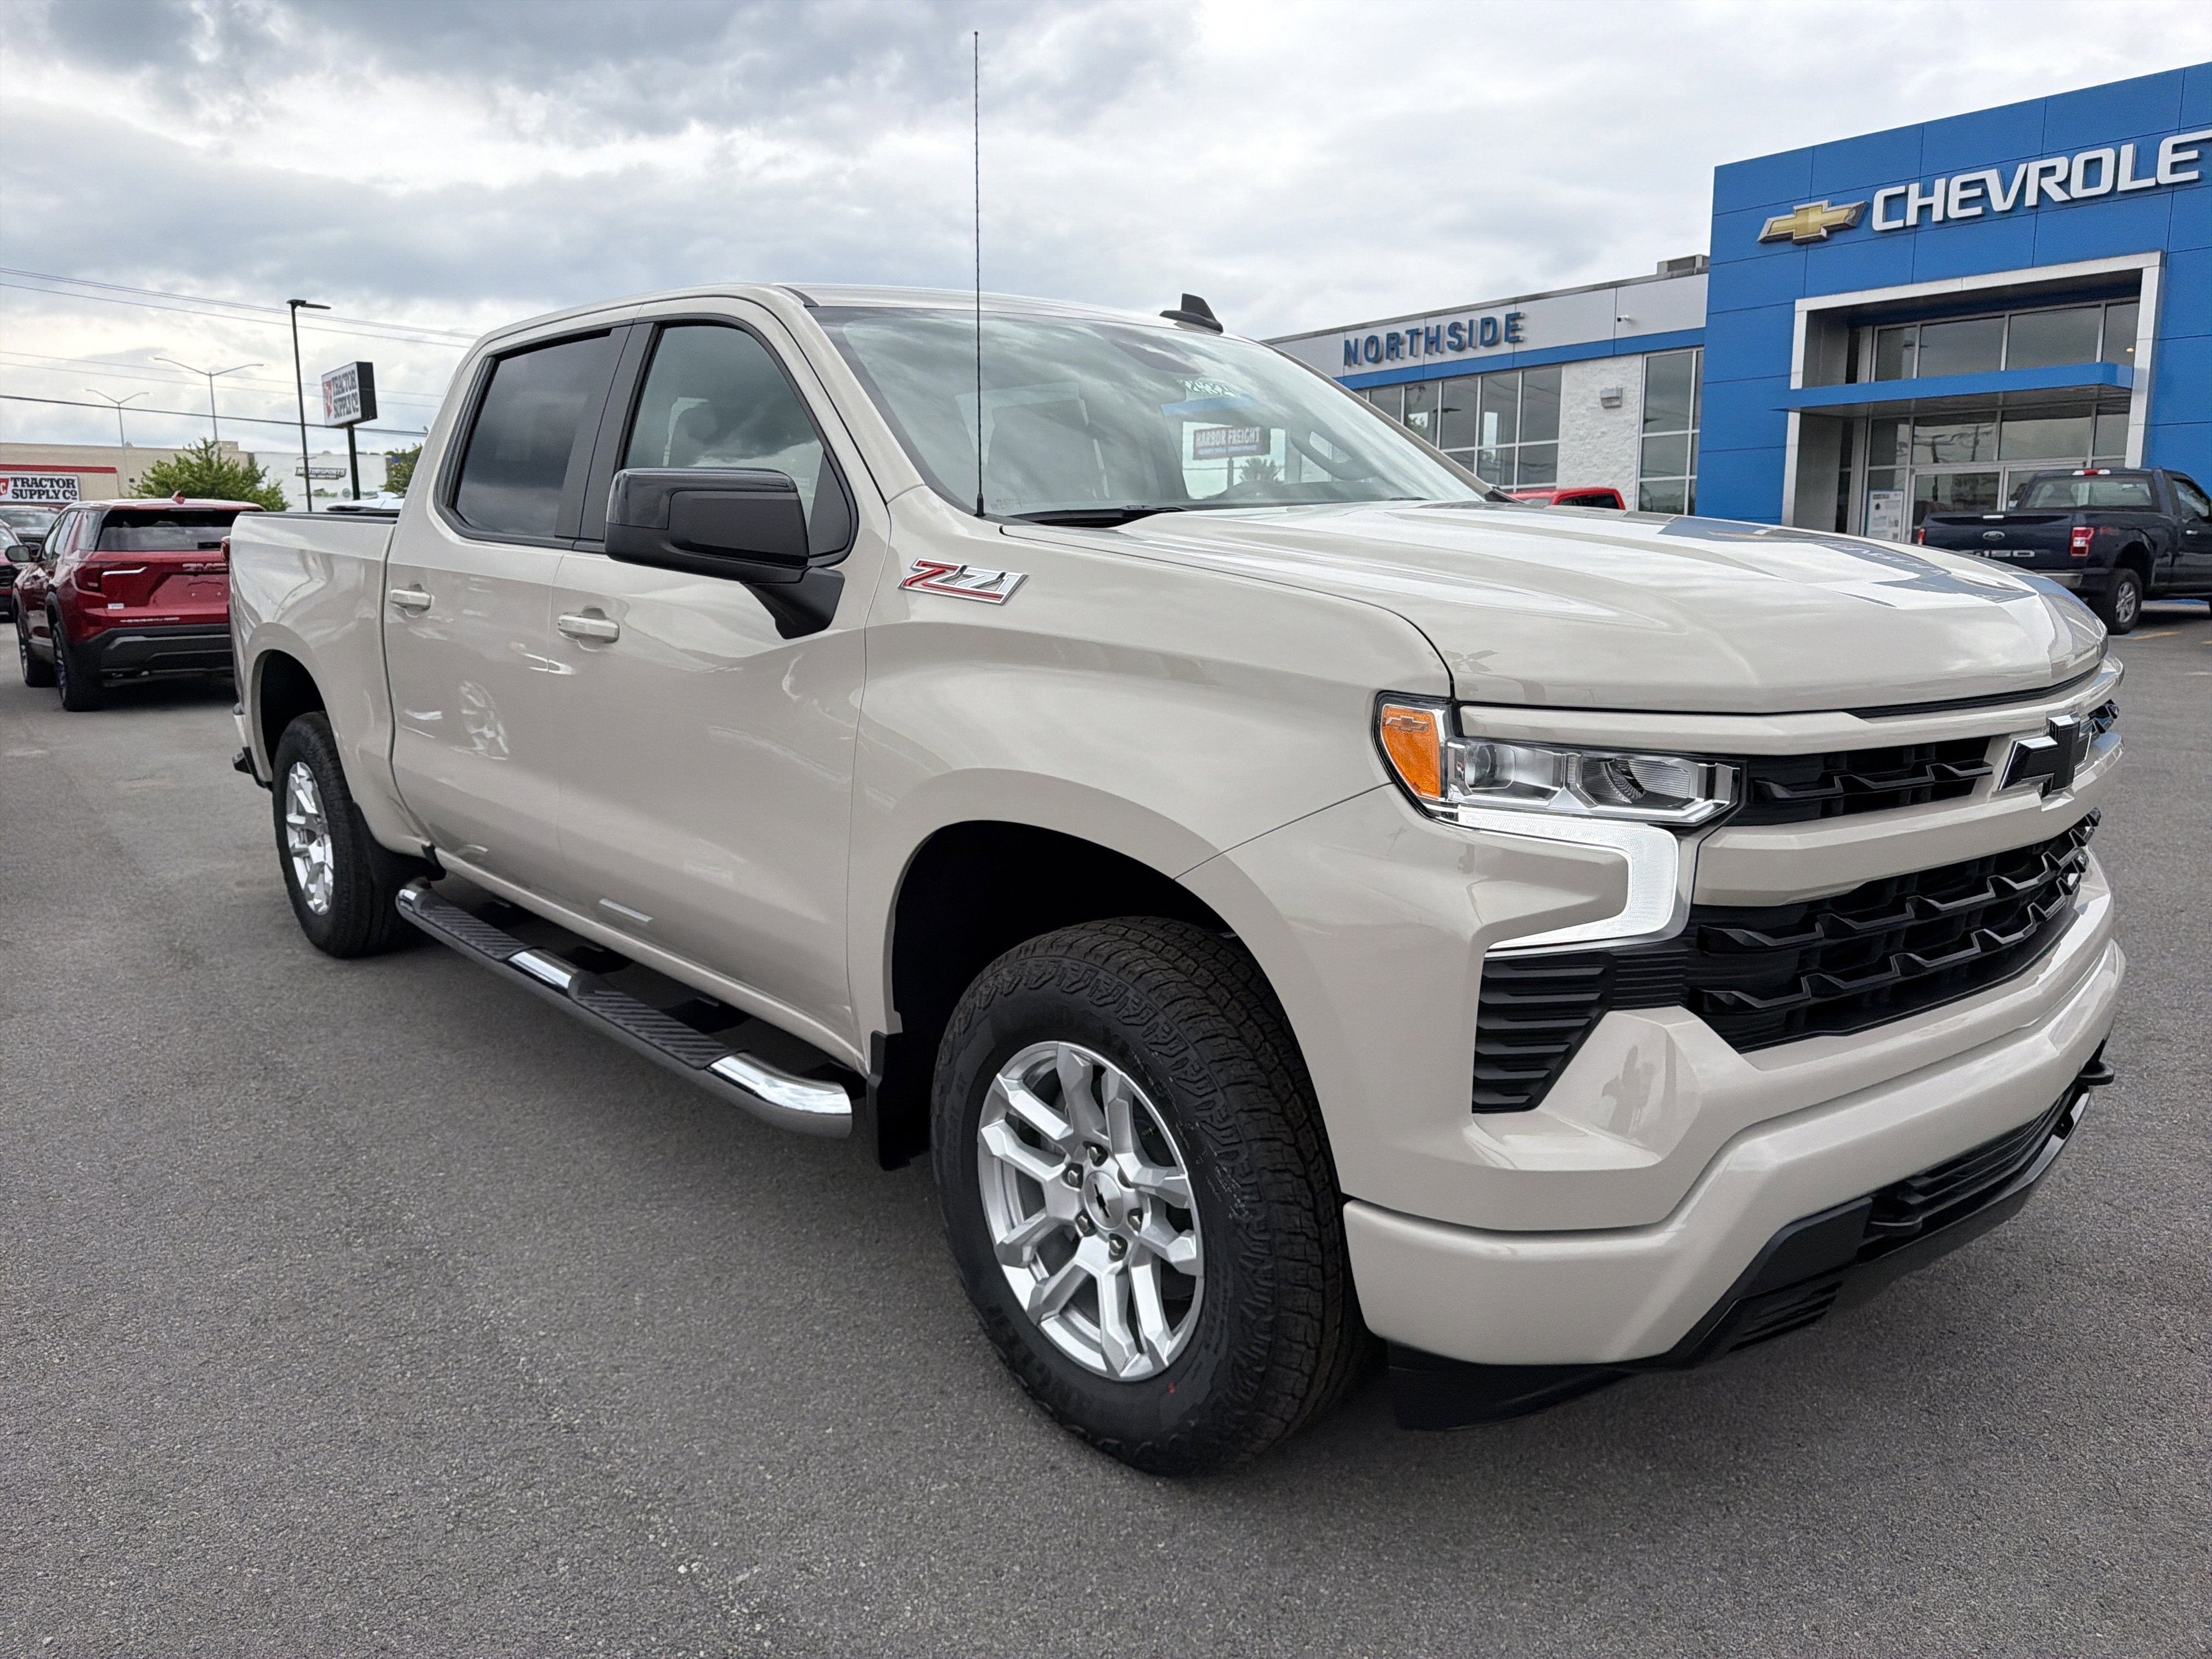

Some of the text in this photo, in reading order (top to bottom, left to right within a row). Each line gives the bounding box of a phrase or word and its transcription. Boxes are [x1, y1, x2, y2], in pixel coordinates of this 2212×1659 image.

[1872, 129, 2212, 232] CHEVROLE
[1344, 312, 1525, 368] NORTHSIDE
[1195, 426, 1261, 447] HARBOR FREIGHT
[10, 477, 76, 489] TRACTOR
[11, 488, 61, 500] SUPPLY
[896, 556, 1029, 606] Z71
